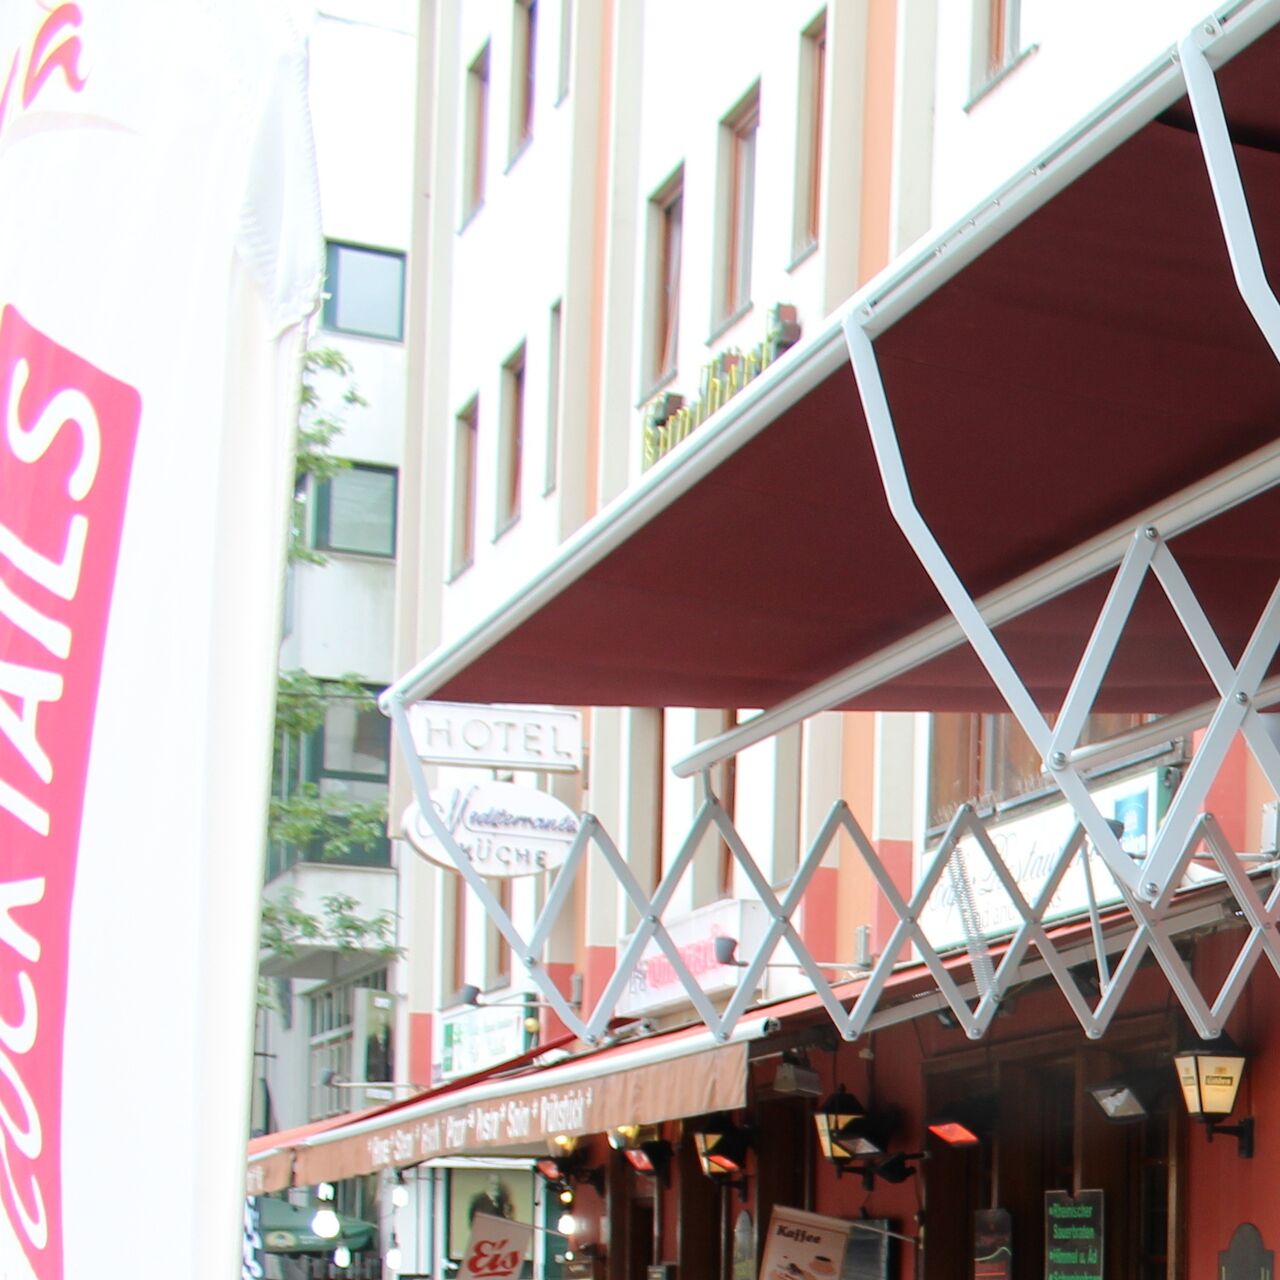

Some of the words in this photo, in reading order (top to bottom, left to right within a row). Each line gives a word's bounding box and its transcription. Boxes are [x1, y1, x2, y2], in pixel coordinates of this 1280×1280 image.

[425, 716, 572, 759] HOTEL
[776, 1224, 822, 1244] Kaffee
[468, 1239, 520, 1275] Eis
